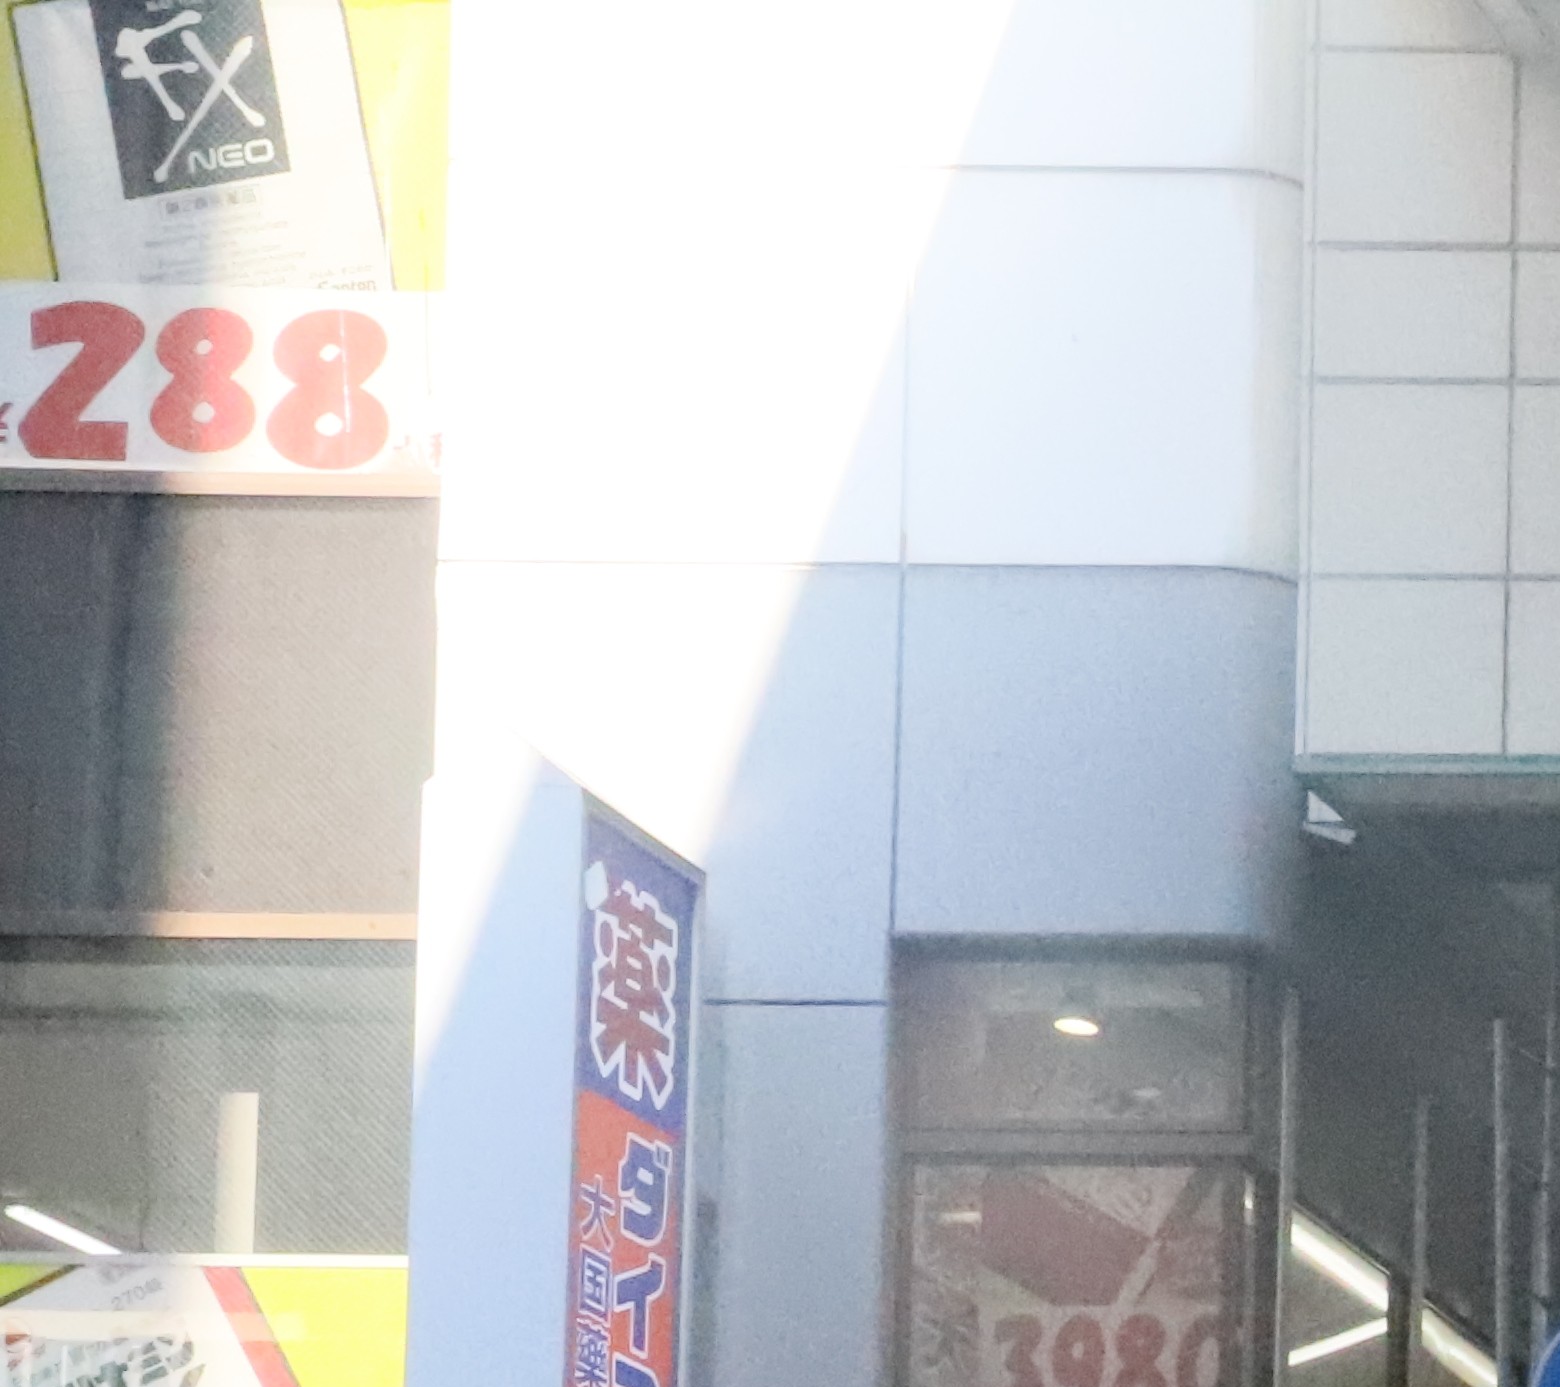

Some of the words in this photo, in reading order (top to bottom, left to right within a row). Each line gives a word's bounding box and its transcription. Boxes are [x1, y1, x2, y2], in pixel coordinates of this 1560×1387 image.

[187, 139, 275, 173] NEO
[18, 301, 389, 470] 288
[585, 860, 677, 1111] 薬
